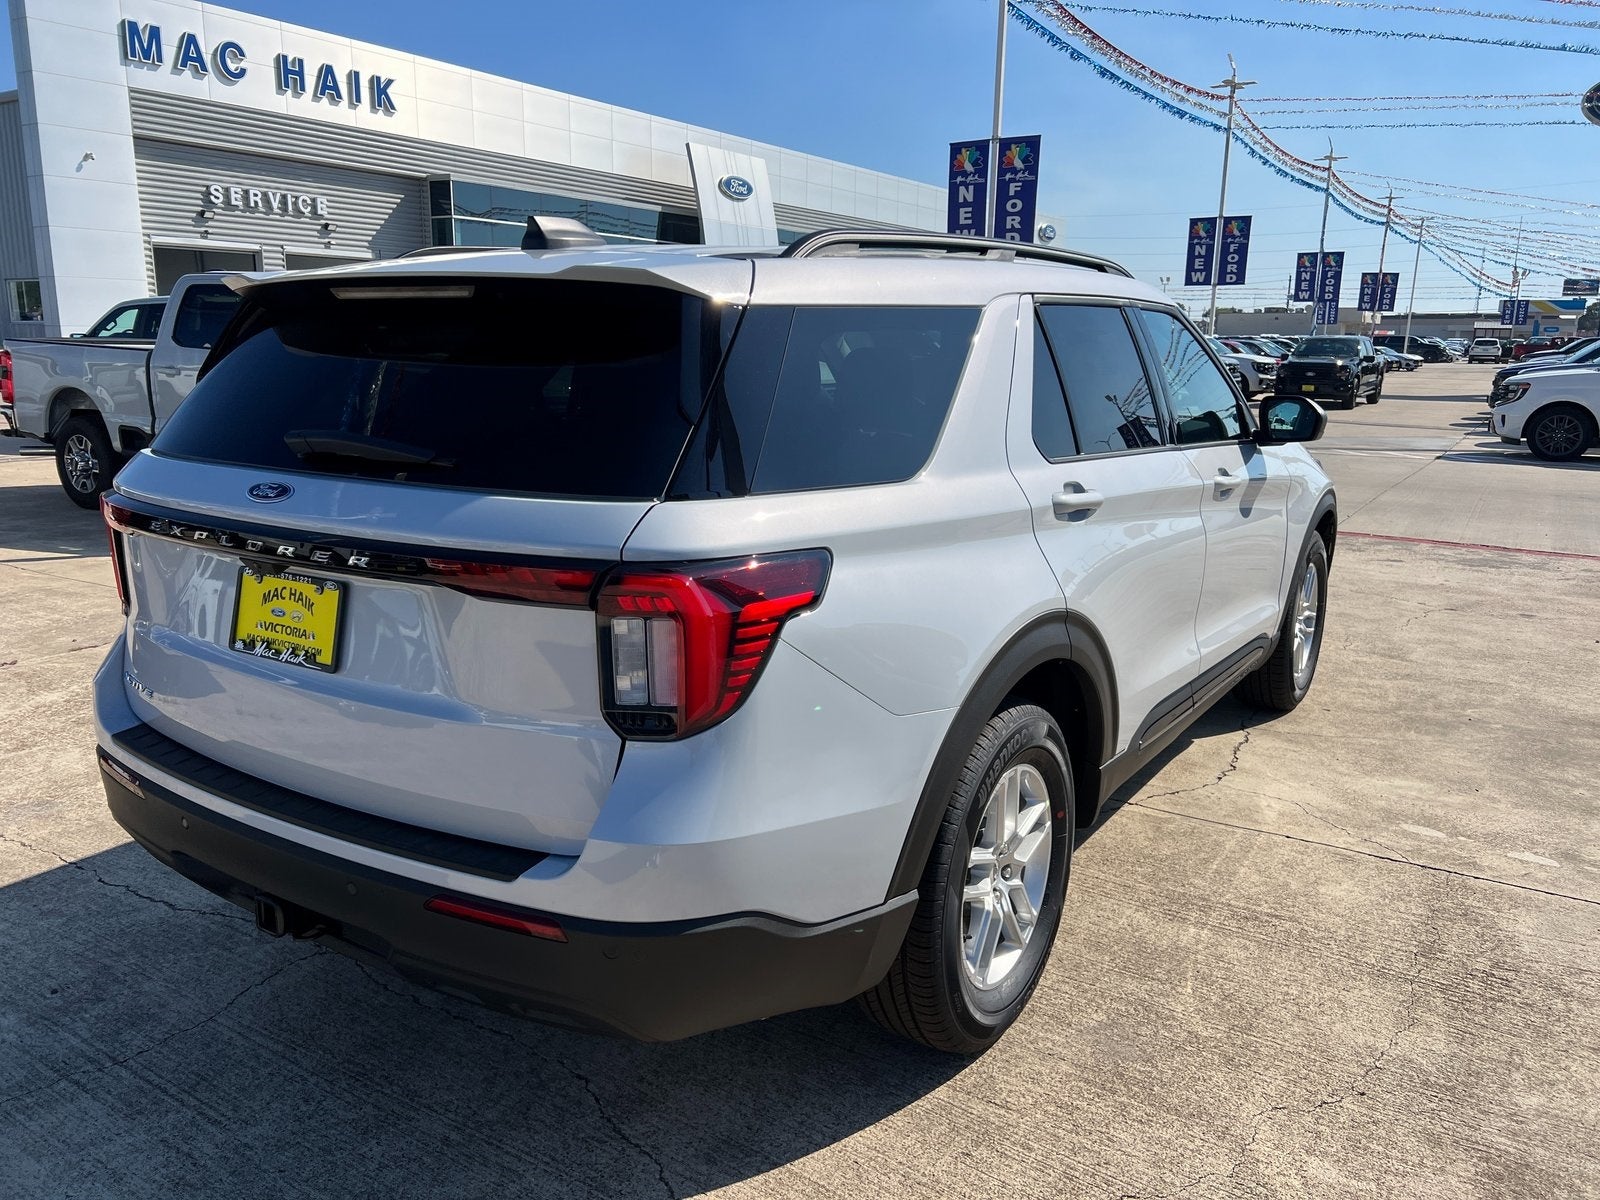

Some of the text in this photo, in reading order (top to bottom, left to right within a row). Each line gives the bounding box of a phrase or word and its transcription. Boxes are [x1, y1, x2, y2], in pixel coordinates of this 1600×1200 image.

[123, 18, 398, 114] MAC HAIK
[208, 184, 329, 216] SERVICE
[729, 178, 748, 194] Ford
[1005, 182, 1023, 242] FORD
[1191, 245, 1206, 283] NEW
[1225, 243, 1239, 283] FORD
[1298, 272, 1310, 300] NEW
[1324, 271, 1335, 300] FORD
[1362, 288, 1371, 310] NEW
[1382, 288, 1392, 310] FORD
[253, 484, 282, 497] Ford
[150, 520, 370, 568] EXPLORER
[261, 586, 315, 616] MAC HAIK
[263, 621, 307, 639] VICTORIA
[253, 641, 313, 666] Mac Haik
